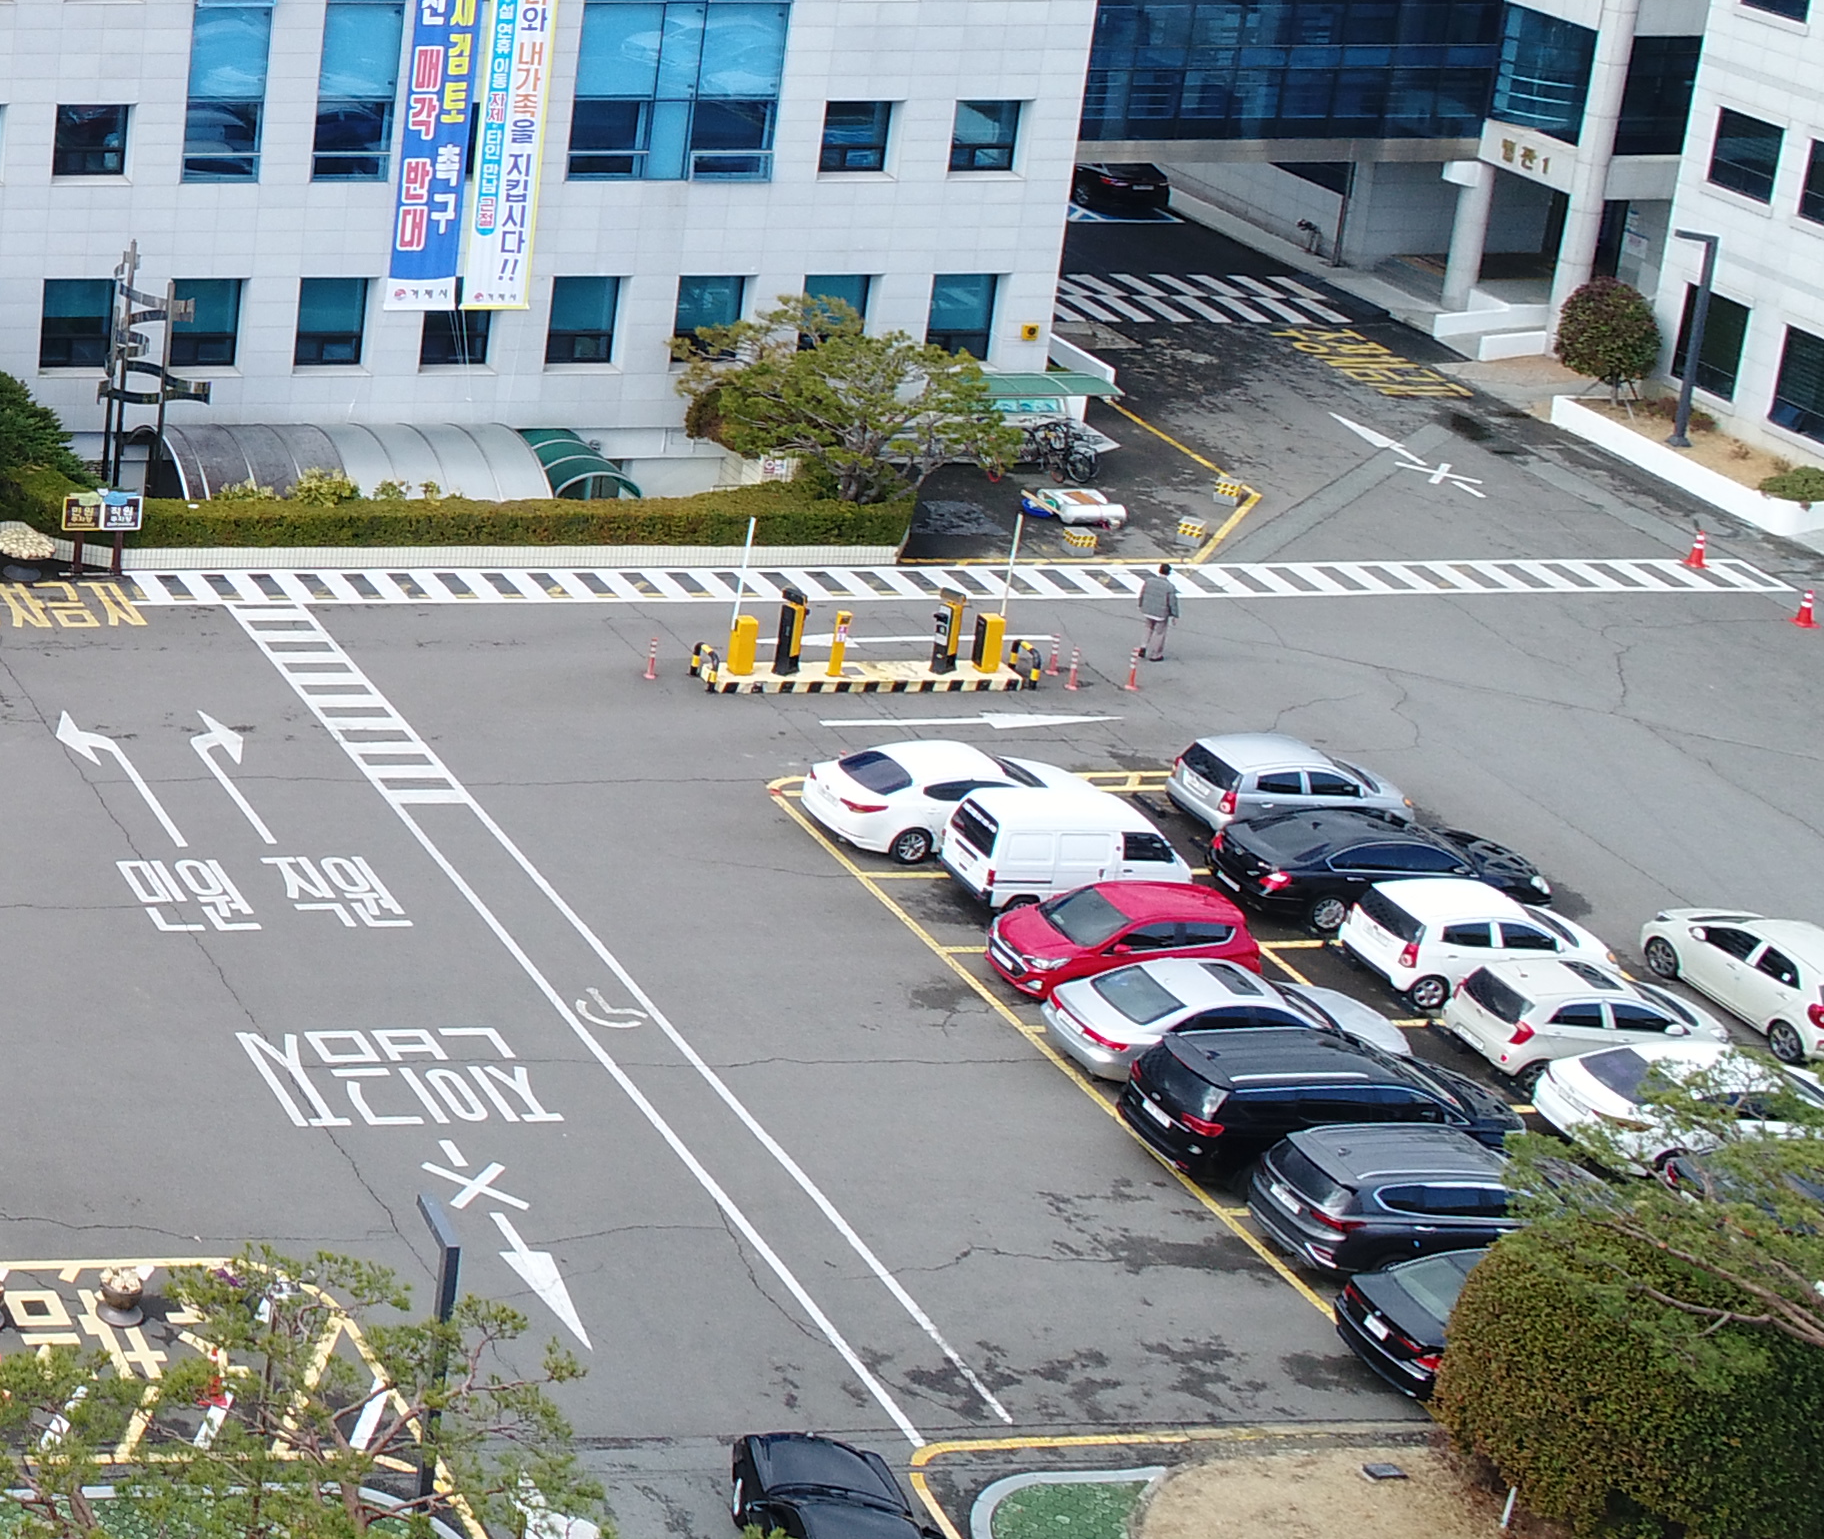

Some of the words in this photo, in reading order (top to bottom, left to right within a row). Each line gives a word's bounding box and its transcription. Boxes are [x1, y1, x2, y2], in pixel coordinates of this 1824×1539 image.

[408, 45, 445, 141] 매각
[395, 158, 433, 252] 반대
[430, 143, 462, 235] 촉구
[115, 859, 263, 932] 민원
[260, 855, 414, 928] 직원
